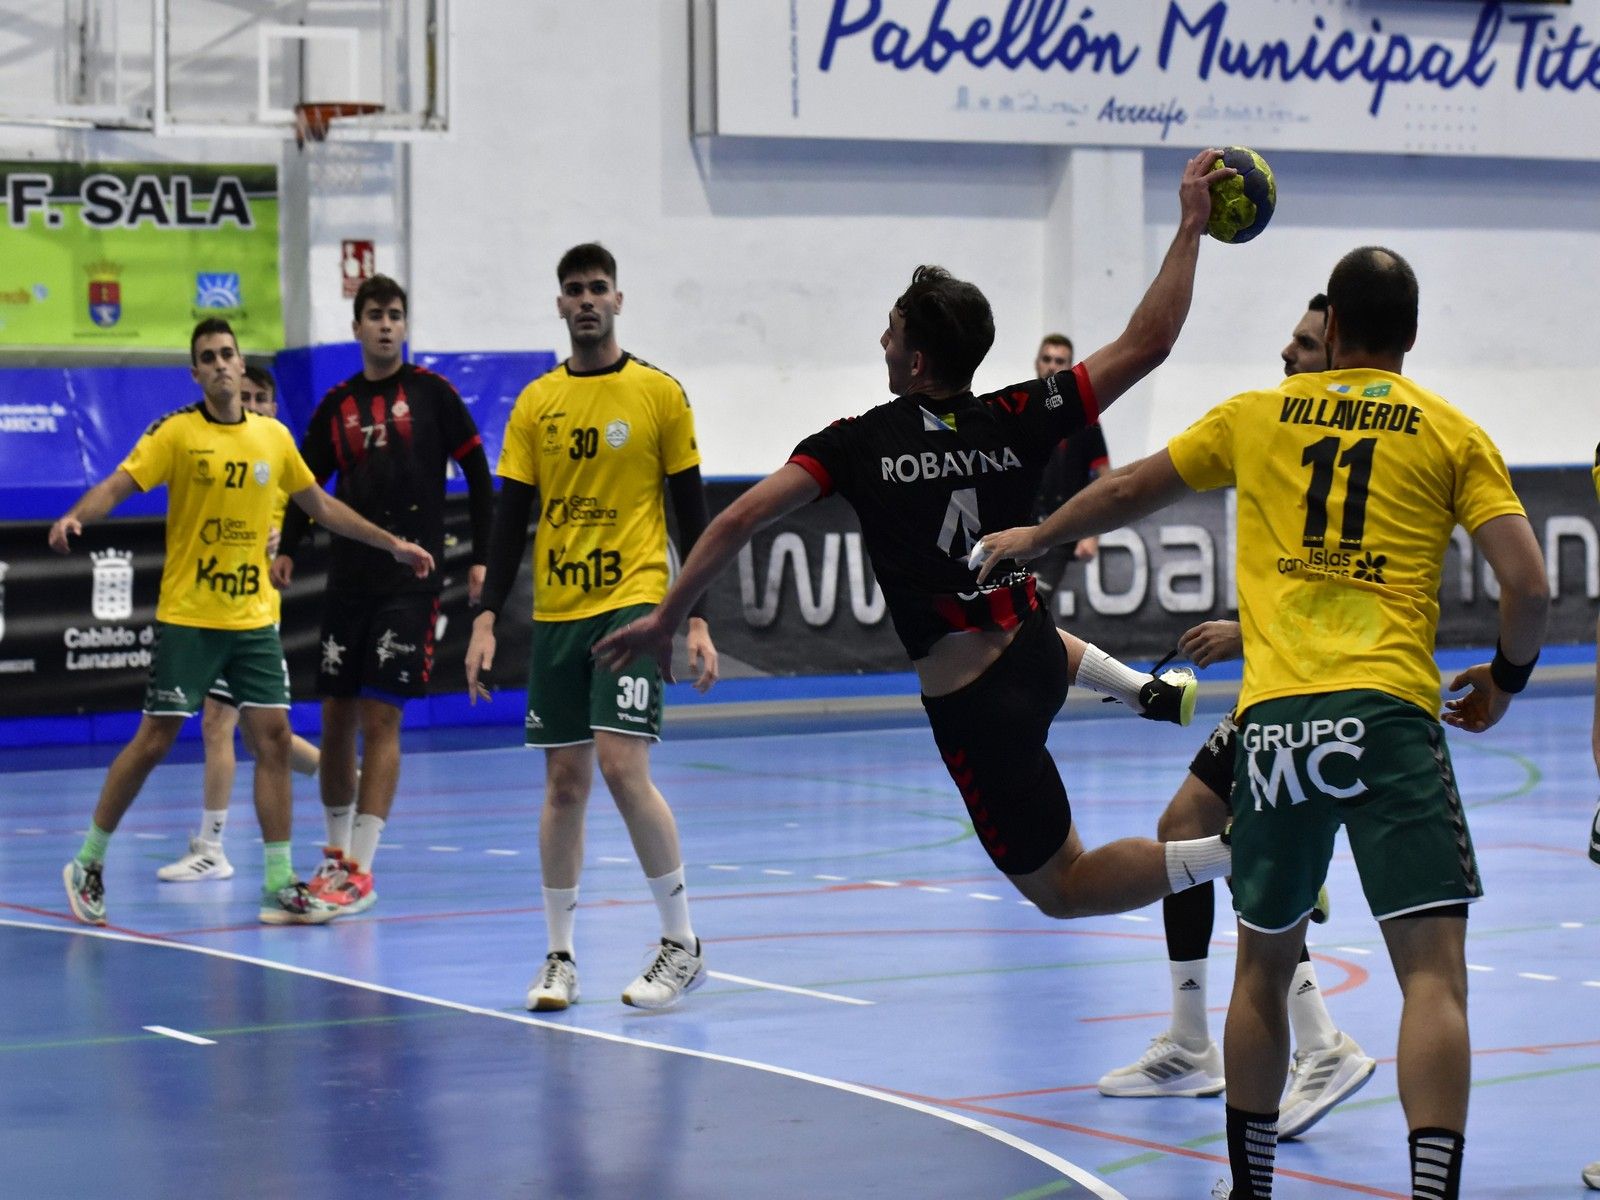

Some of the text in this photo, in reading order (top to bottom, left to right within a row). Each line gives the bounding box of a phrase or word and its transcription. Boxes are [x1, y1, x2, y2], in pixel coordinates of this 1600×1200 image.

[818, 0, 1139, 74] Pabellón
[1157, 0, 1497, 117] Municipal
[1098, 97, 1188, 141] Arrecife
[8, 174, 254, 229] F. SALA
[1279, 396, 1423, 435] VILLAVERDE
[361, 424, 387, 449] 72
[569, 427, 599, 460] 30
[225, 461, 248, 488] 27
[881, 446, 1023, 484] ROBAYNA
[570, 496, 597, 507] Gran
[1301, 435, 1378, 550] 11
[1308, 548, 1352, 567] Islas
[64, 627, 136, 648] Cabildo
[616, 675, 649, 711] 30
[1243, 717, 1365, 752] GRUPO
[1247, 740, 1369, 811] MC
